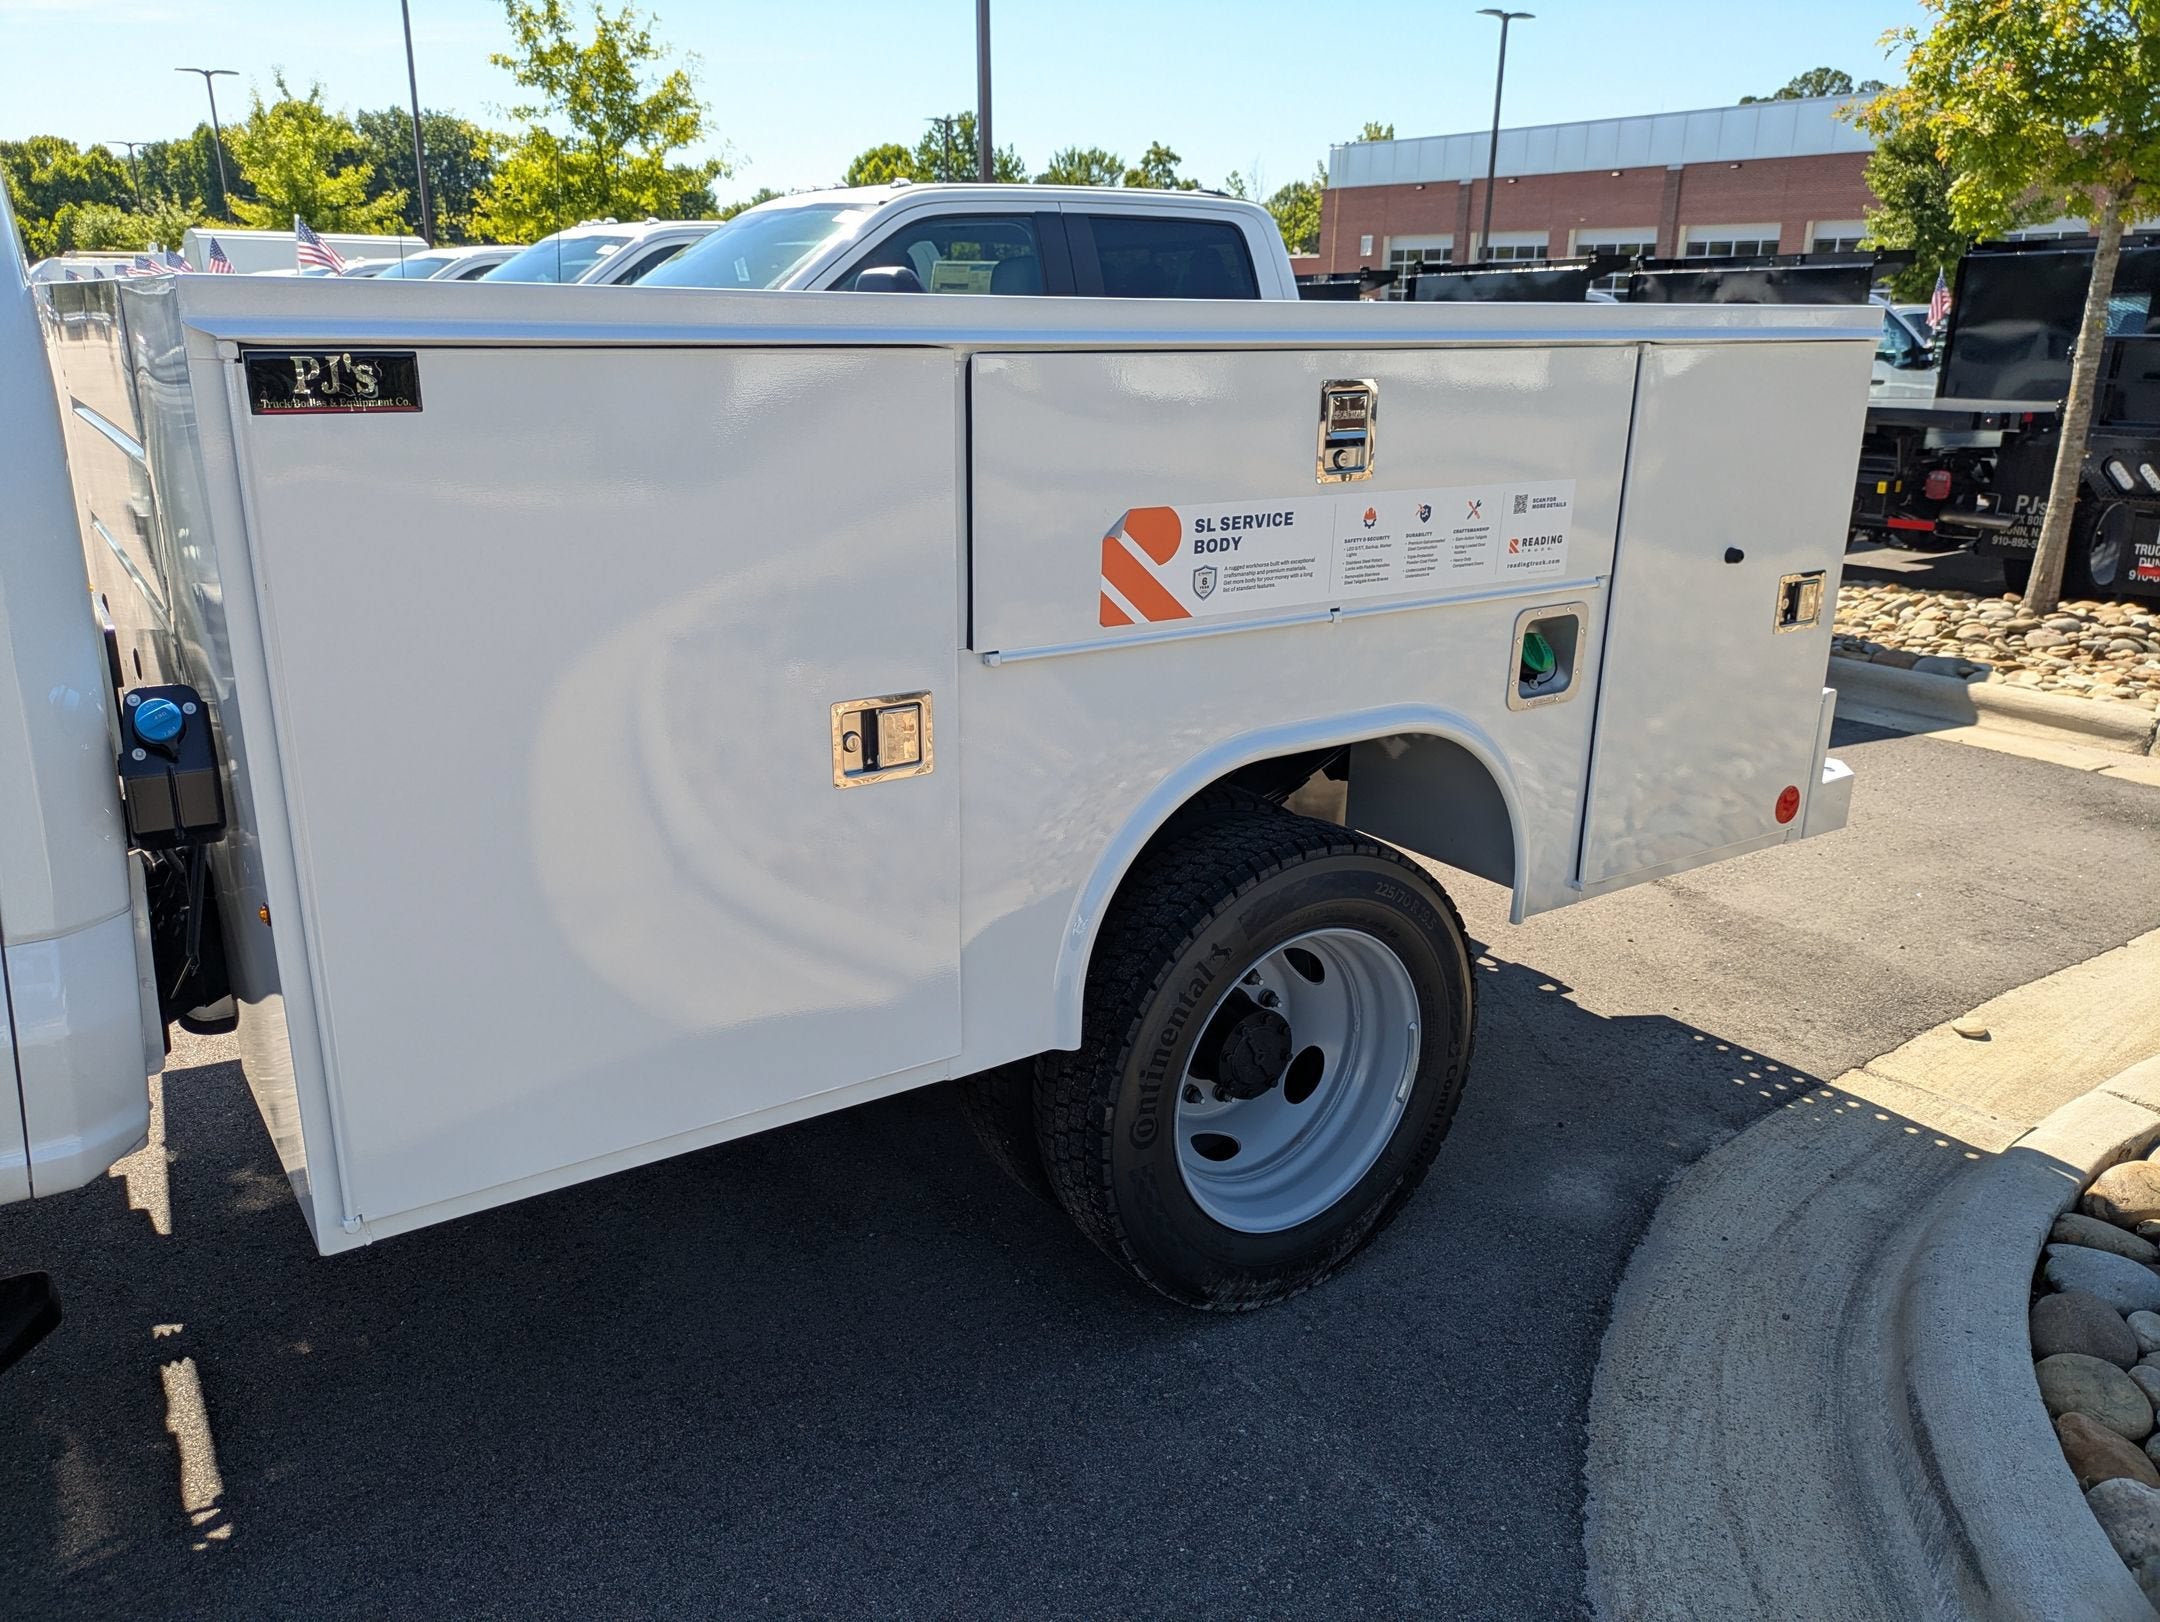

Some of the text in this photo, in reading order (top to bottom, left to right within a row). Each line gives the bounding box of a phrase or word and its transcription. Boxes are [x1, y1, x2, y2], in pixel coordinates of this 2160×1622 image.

[289, 352, 378, 395] PJ's
[260, 397, 412, 409] Truck Bodies & Equipment Co.
[1195, 512, 1294, 533] SL SERVICE
[1194, 536, 1242, 554] BODY
[1522, 535, 1563, 547] READING
[1507, 559, 1560, 569] readingtruck.com
[1202, 577, 1208, 585] 6
[1375, 882, 1412, 908] 225/70
[1129, 962, 1216, 1150] Continental
